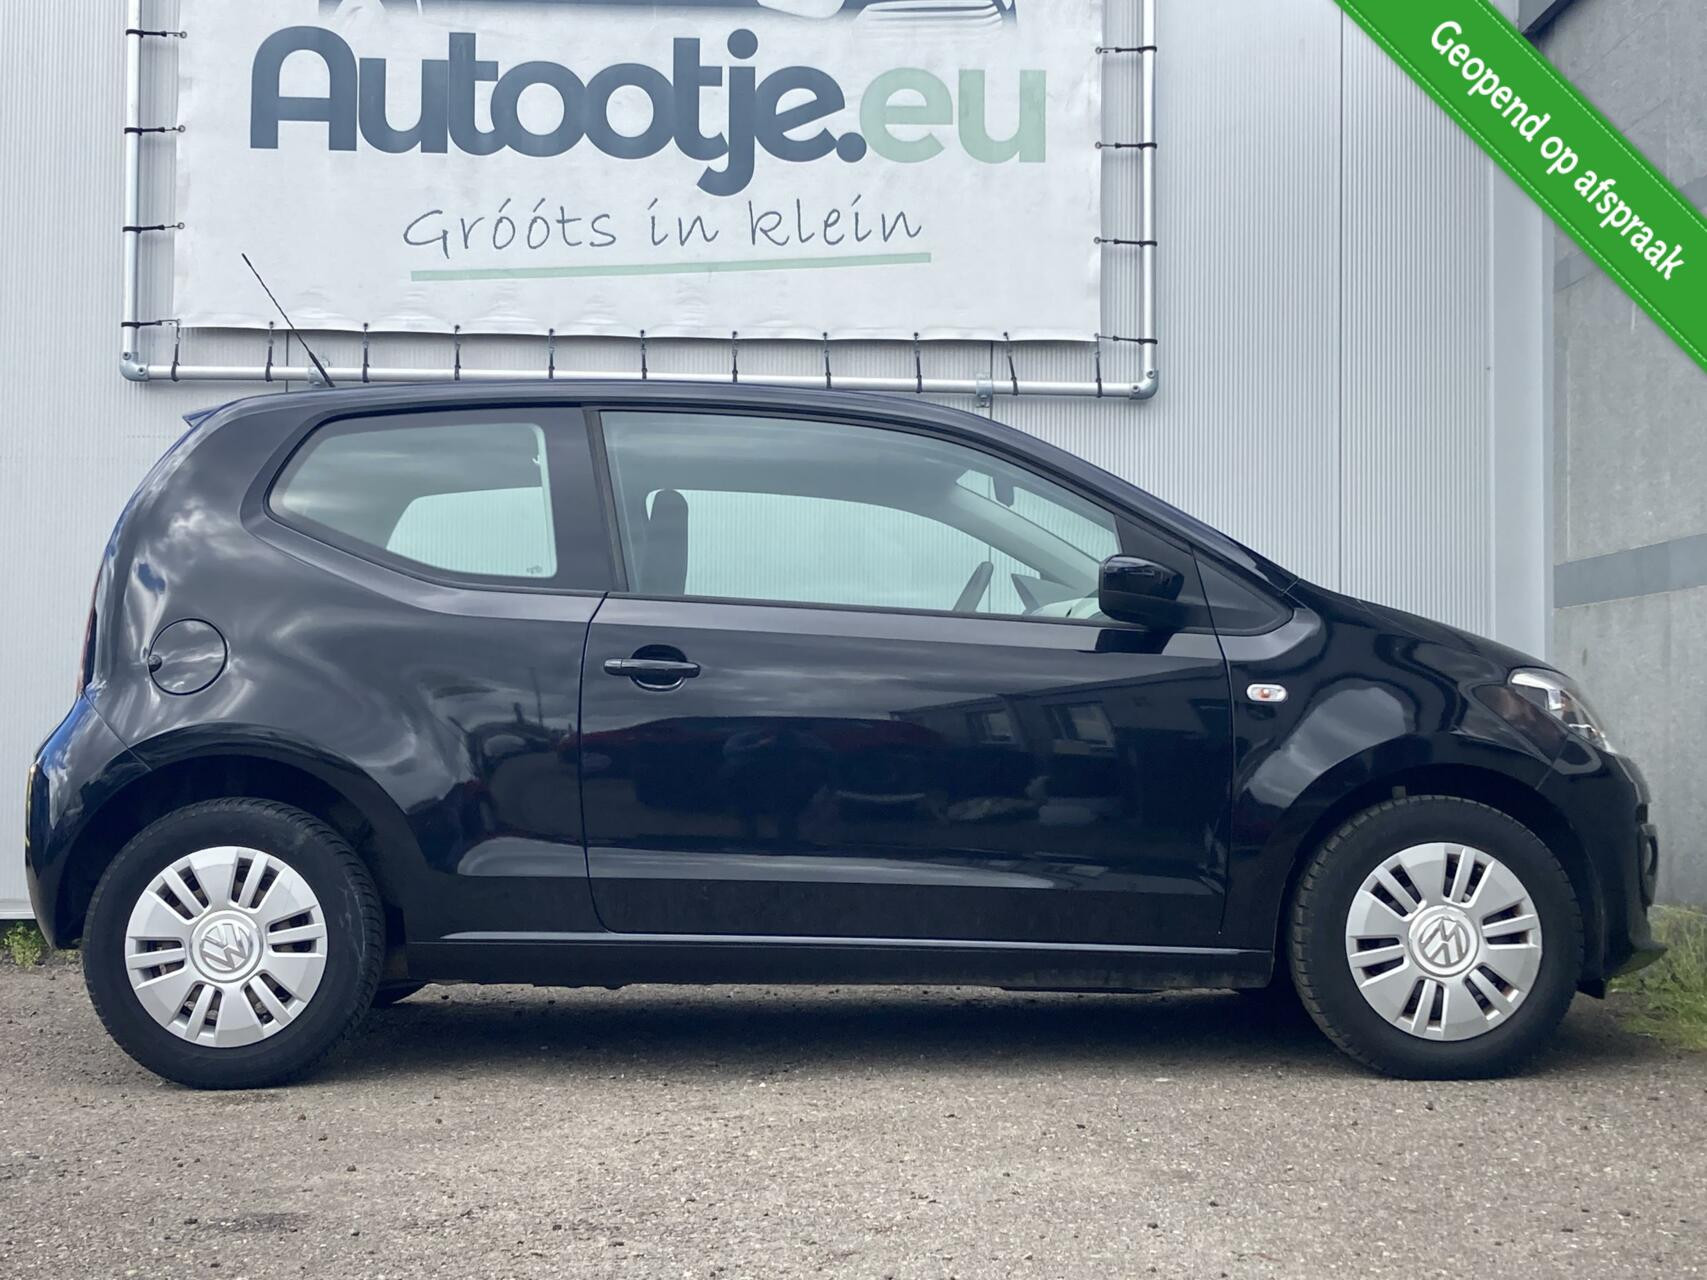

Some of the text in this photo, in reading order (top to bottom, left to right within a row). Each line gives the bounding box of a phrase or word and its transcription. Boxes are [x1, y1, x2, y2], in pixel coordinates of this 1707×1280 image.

[249, 26, 1046, 197] Autootje.eu
[402, 194, 923, 260] Gróóts in klein
